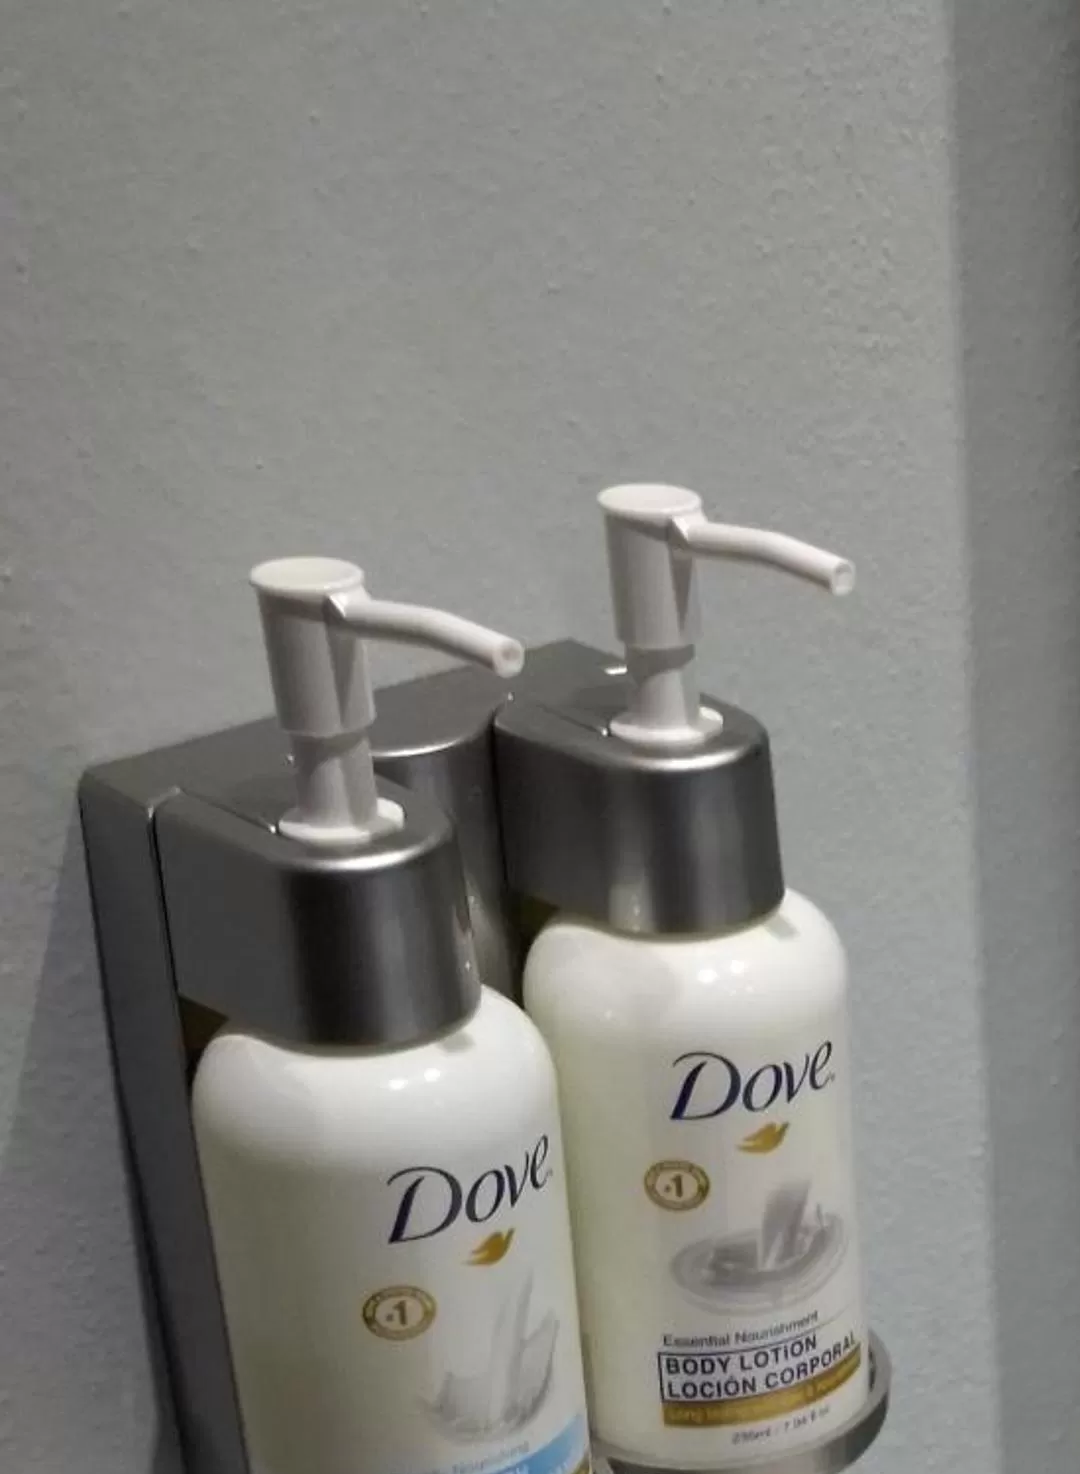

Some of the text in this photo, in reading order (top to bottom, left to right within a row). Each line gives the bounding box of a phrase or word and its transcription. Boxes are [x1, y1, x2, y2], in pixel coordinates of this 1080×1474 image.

[670, 1040, 829, 1121] Dove
[387, 1134, 549, 1244] Dove
[666, 1334, 818, 1376] BODY LOTION
[668, 1374, 757, 1399] LOCIÓN
[765, 1331, 857, 1389] CORPORAL
